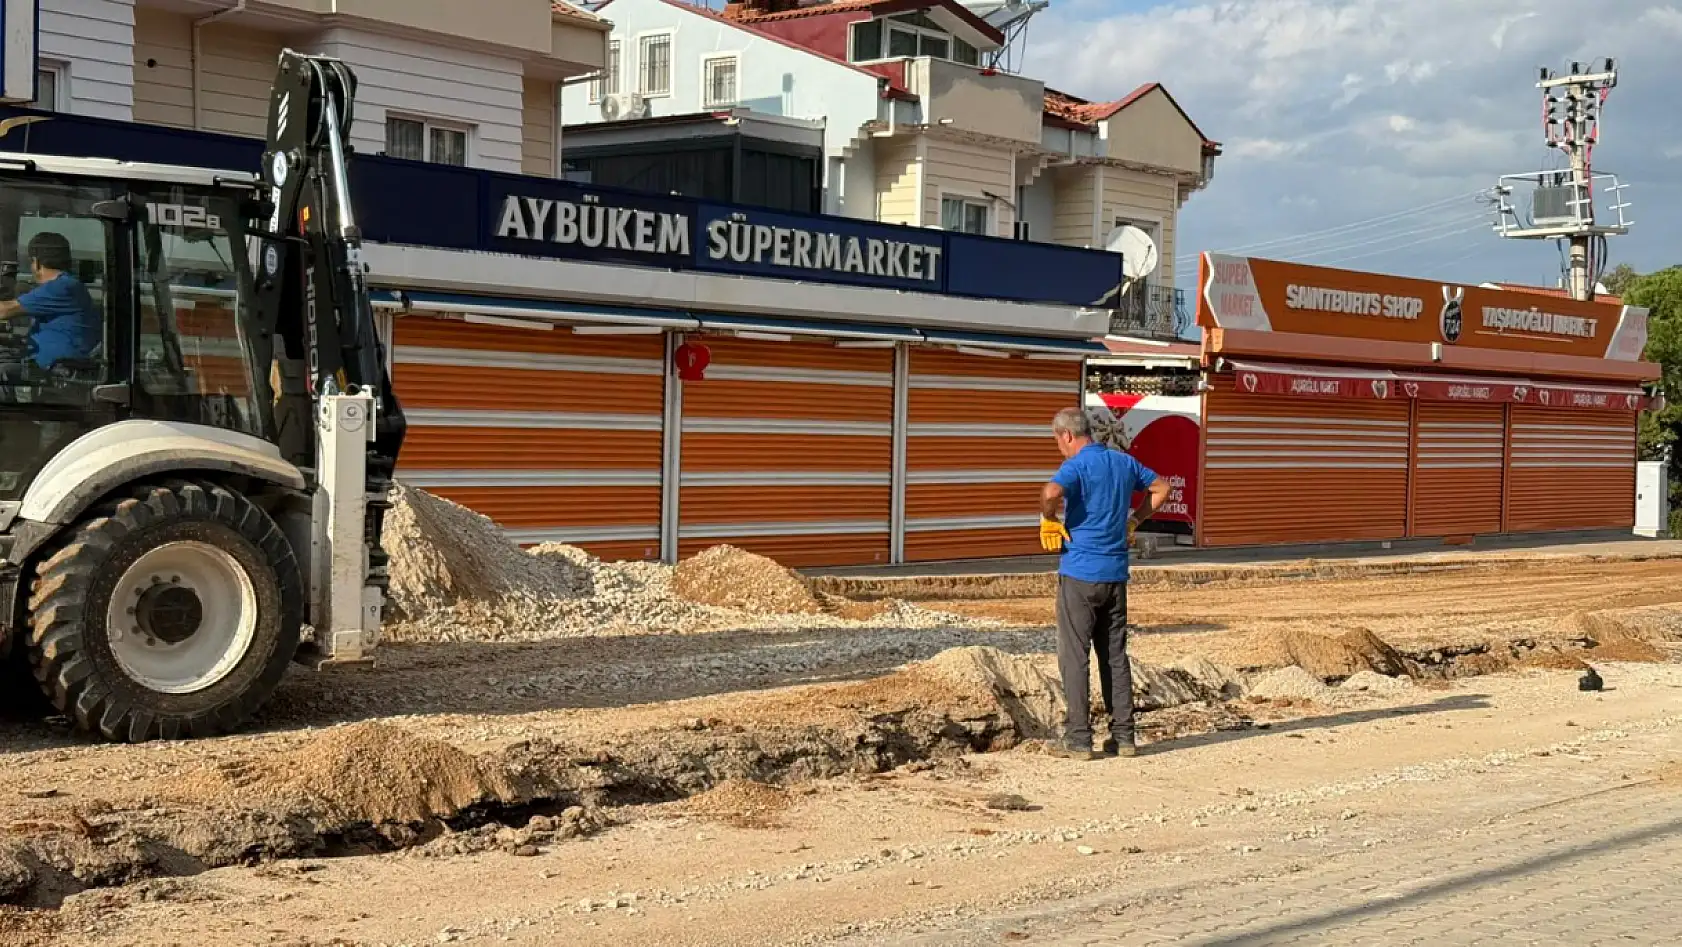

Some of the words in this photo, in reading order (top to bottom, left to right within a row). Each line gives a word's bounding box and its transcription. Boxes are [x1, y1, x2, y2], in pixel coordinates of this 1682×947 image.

[496, 193, 690, 256] AYBÜKEM
[707, 212, 942, 282] SÜPERMARKET
[1214, 262, 1248, 286] SUPER
[1383, 294, 1423, 320] SHOP
[1553, 314, 1598, 338] MARKET
